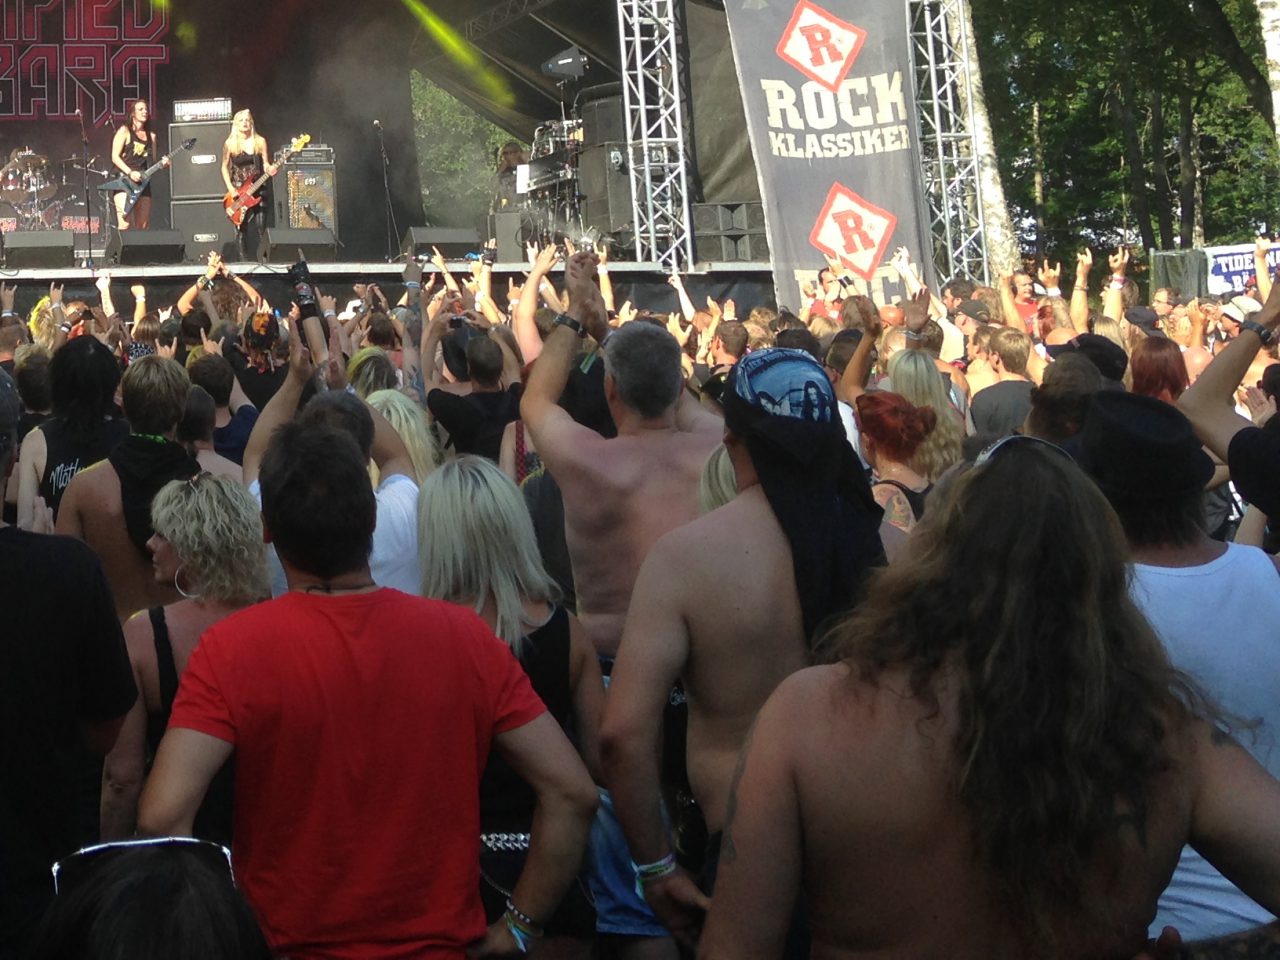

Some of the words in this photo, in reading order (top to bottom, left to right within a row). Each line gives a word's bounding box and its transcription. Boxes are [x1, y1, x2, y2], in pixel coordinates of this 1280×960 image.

[800, 23, 843, 66] R
[760, 71, 908, 130] ROCK
[831, 209, 875, 255] R
